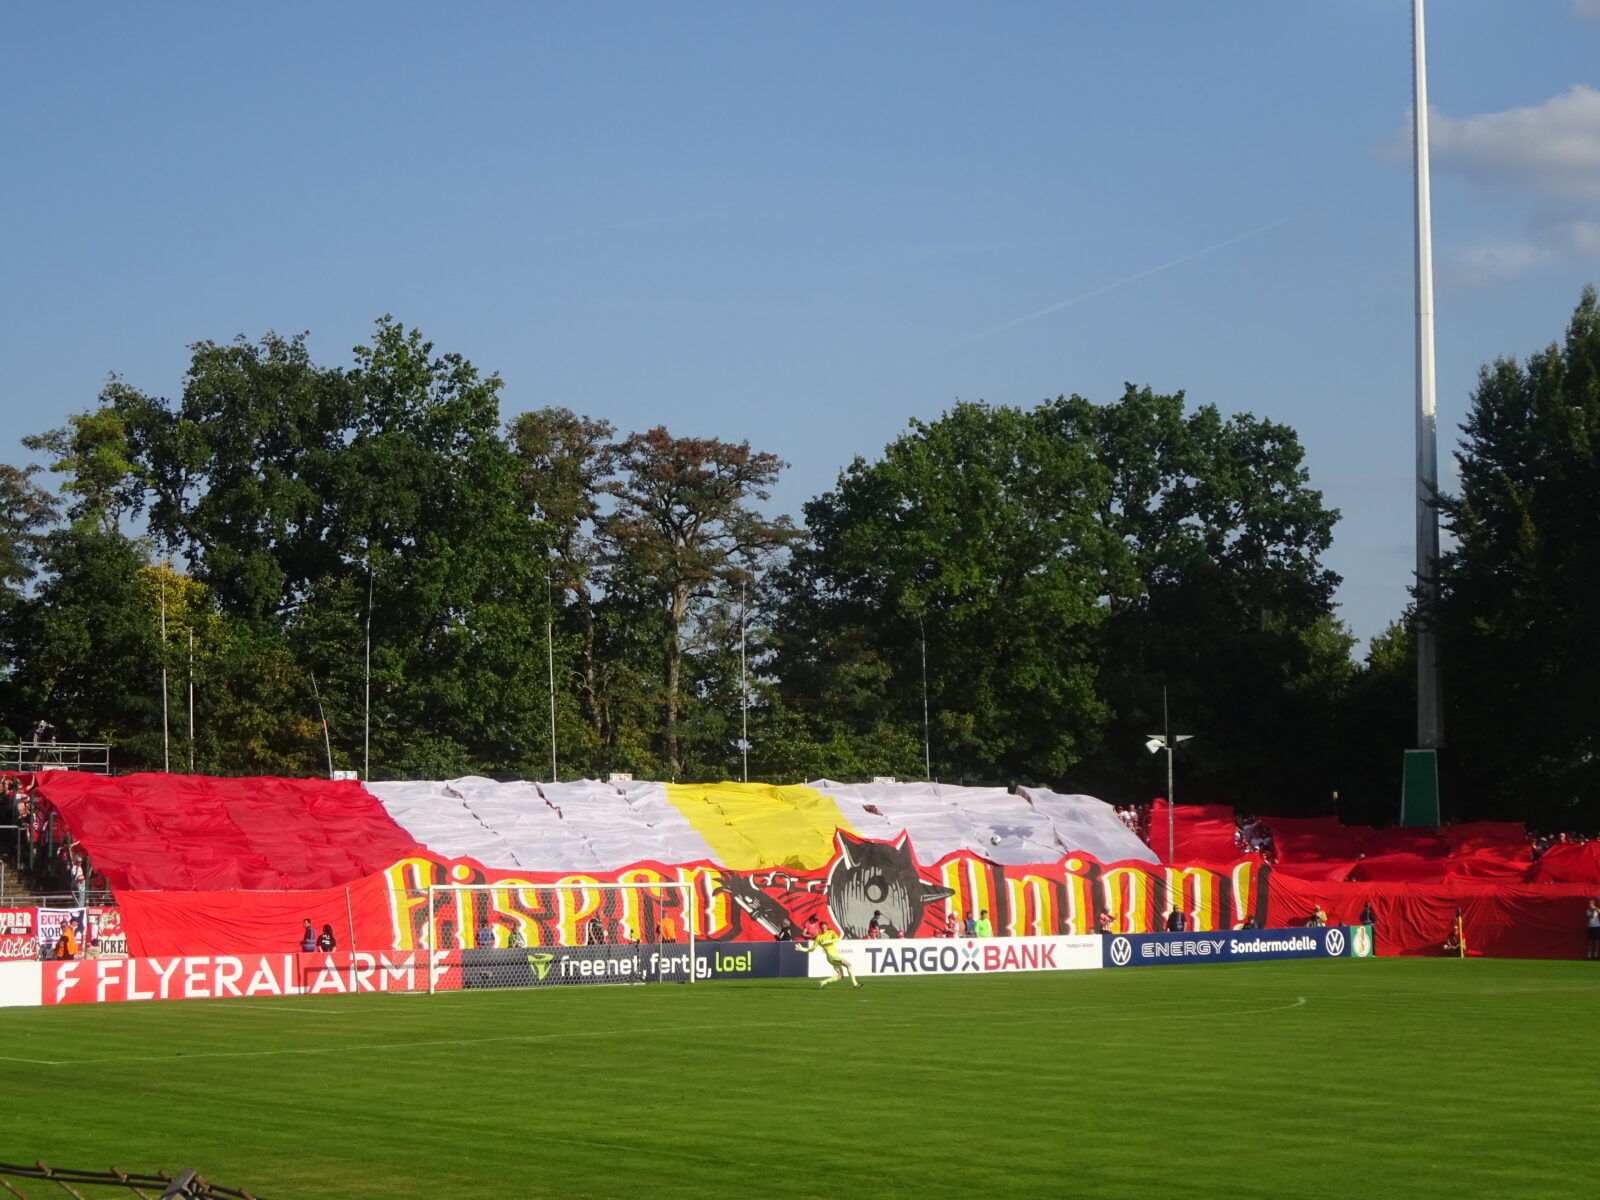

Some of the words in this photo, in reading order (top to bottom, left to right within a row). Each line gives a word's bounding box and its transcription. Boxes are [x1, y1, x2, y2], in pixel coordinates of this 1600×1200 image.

[1141, 940, 1225, 958] ENERGY
[1230, 936, 1317, 954] Sondermodelle
[715, 950, 752, 972] los!
[97, 951, 415, 1002] FLYERALARM
